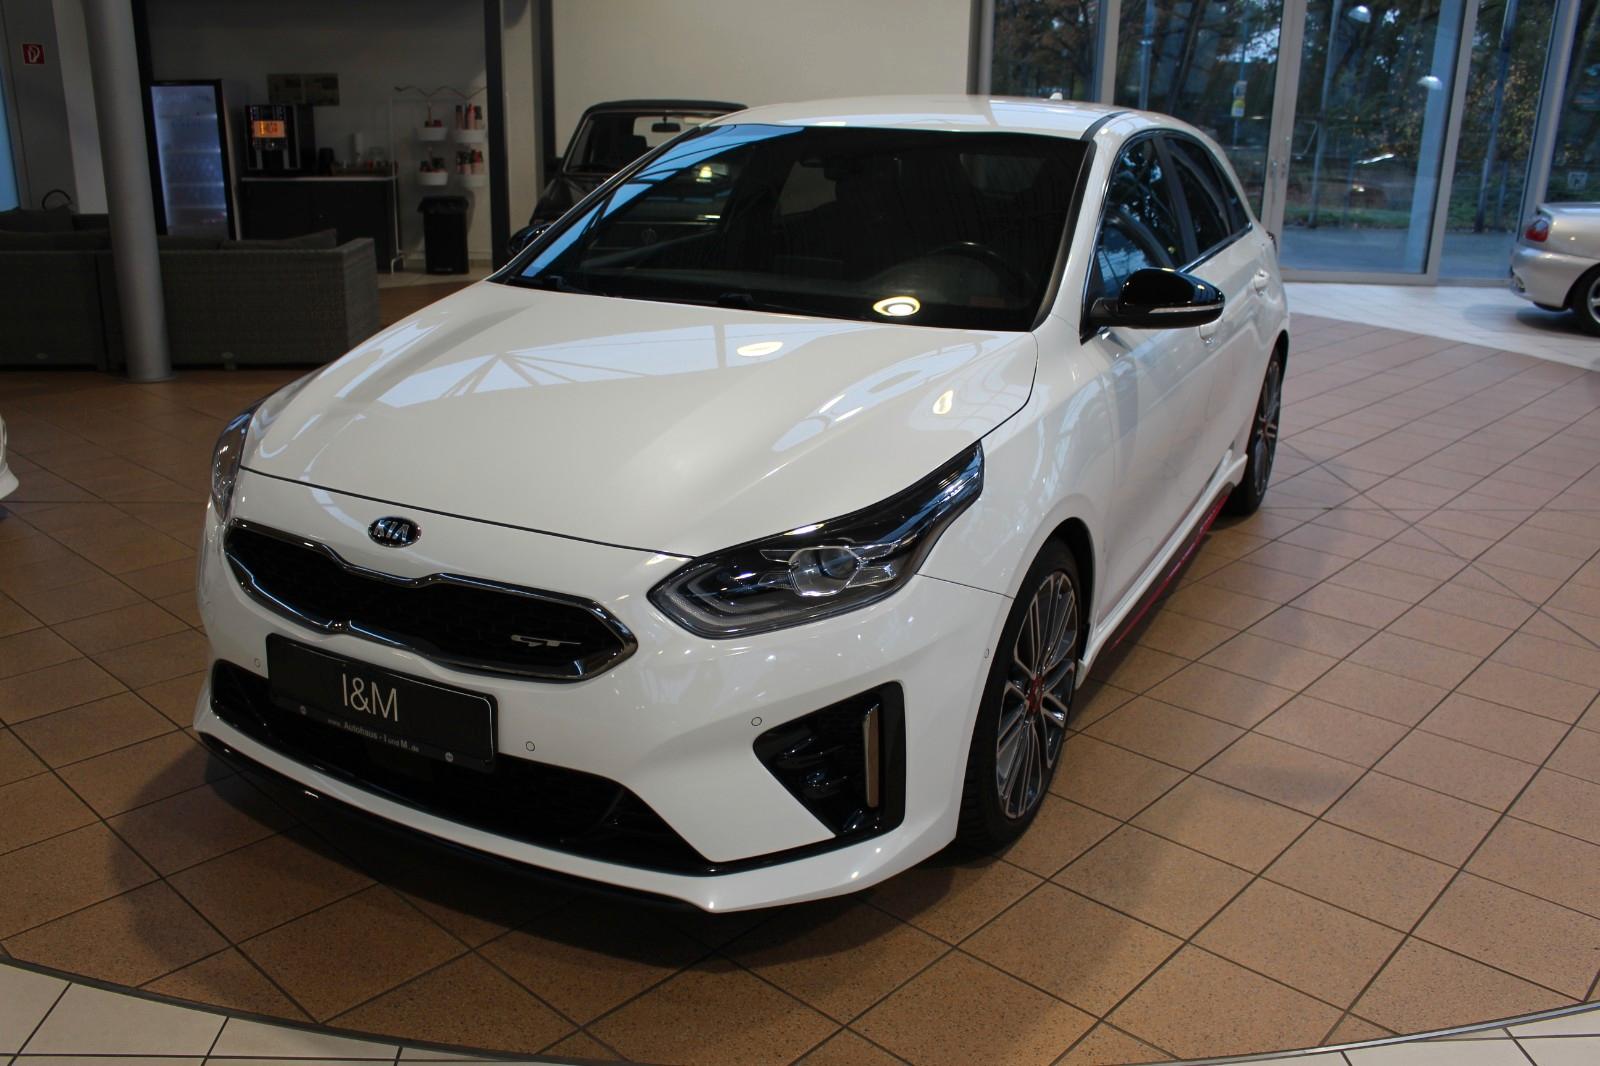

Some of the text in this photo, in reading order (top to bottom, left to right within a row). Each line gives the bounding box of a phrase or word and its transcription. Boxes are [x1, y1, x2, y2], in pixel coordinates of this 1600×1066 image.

[373, 519, 411, 543] KIA
[342, 673, 399, 722] I&M
[343, 720, 378, 740] Autohaus
